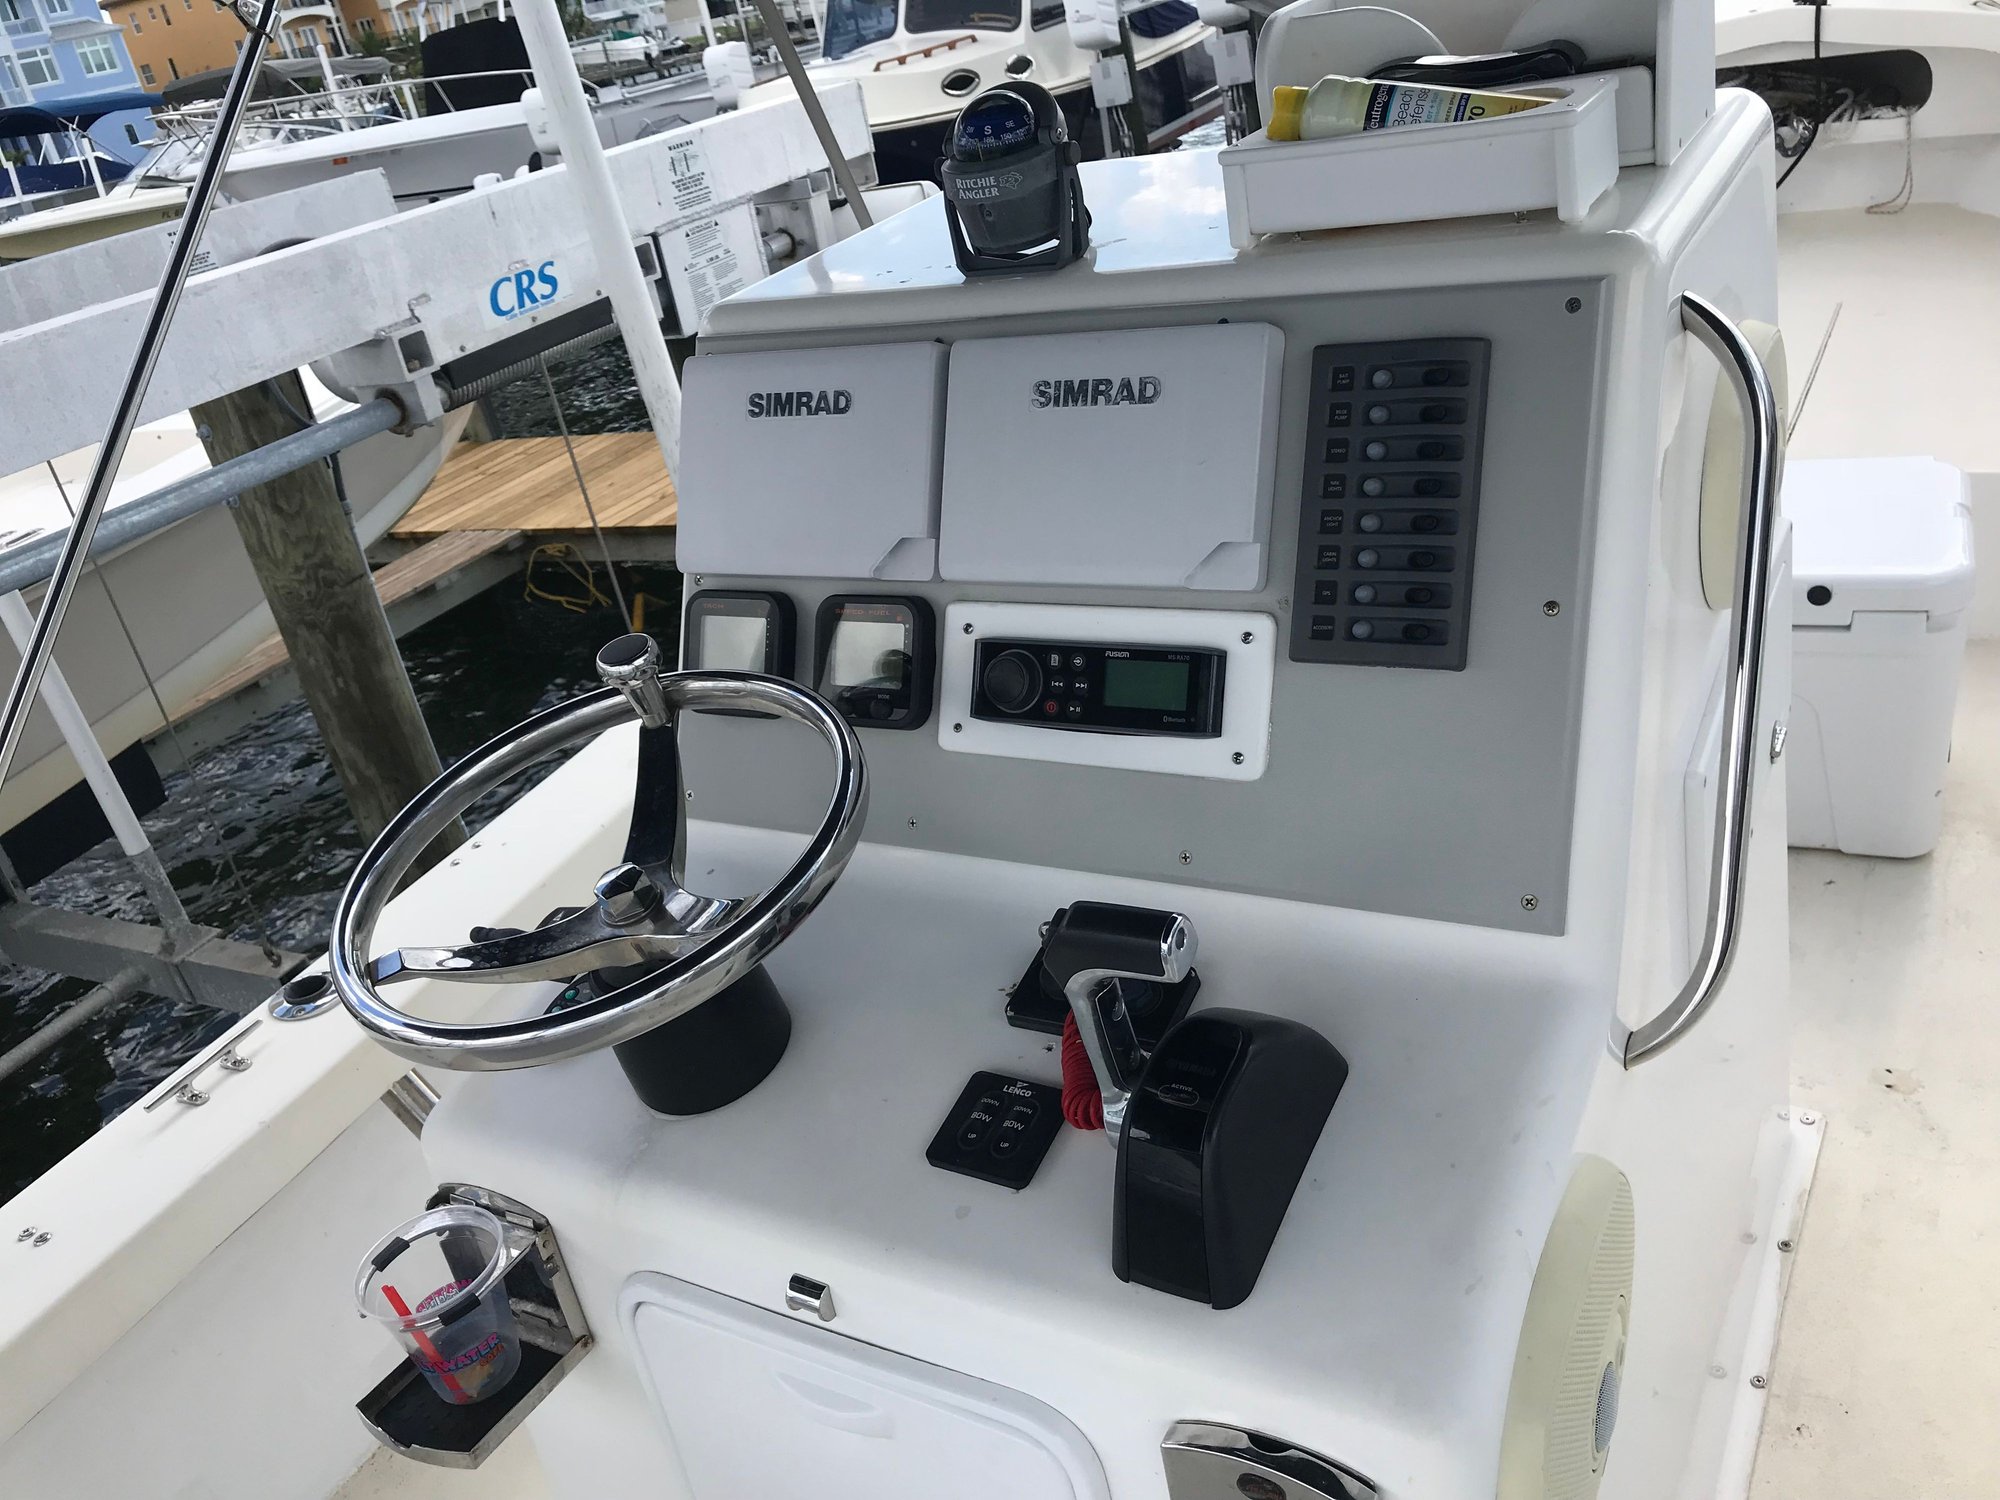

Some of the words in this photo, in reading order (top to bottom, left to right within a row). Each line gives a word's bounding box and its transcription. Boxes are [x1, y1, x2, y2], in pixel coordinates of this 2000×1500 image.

[984, 125, 992, 135] S
[1005, 120, 1015, 128] SE
[1000, 132, 1012, 140] 150
[955, 175, 998, 190] RITCHIE
[958, 187, 1000, 200] ANGLER
[489, 260, 558, 317] CRS
[1030, 375, 1162, 409] SIMRAD
[747, 390, 853, 419] SIMRAD
[1003, 1084, 1033, 1098] LENCO
[1170, 1083, 1193, 1093] ACTIVE
[980, 1097, 1000, 1107] DOWN
[1013, 1105, 1033, 1115] DOWN
[970, 1110, 992, 1123] BOW
[1003, 1118, 1025, 1131] BOW
[1000, 1141, 1010, 1149] UP
